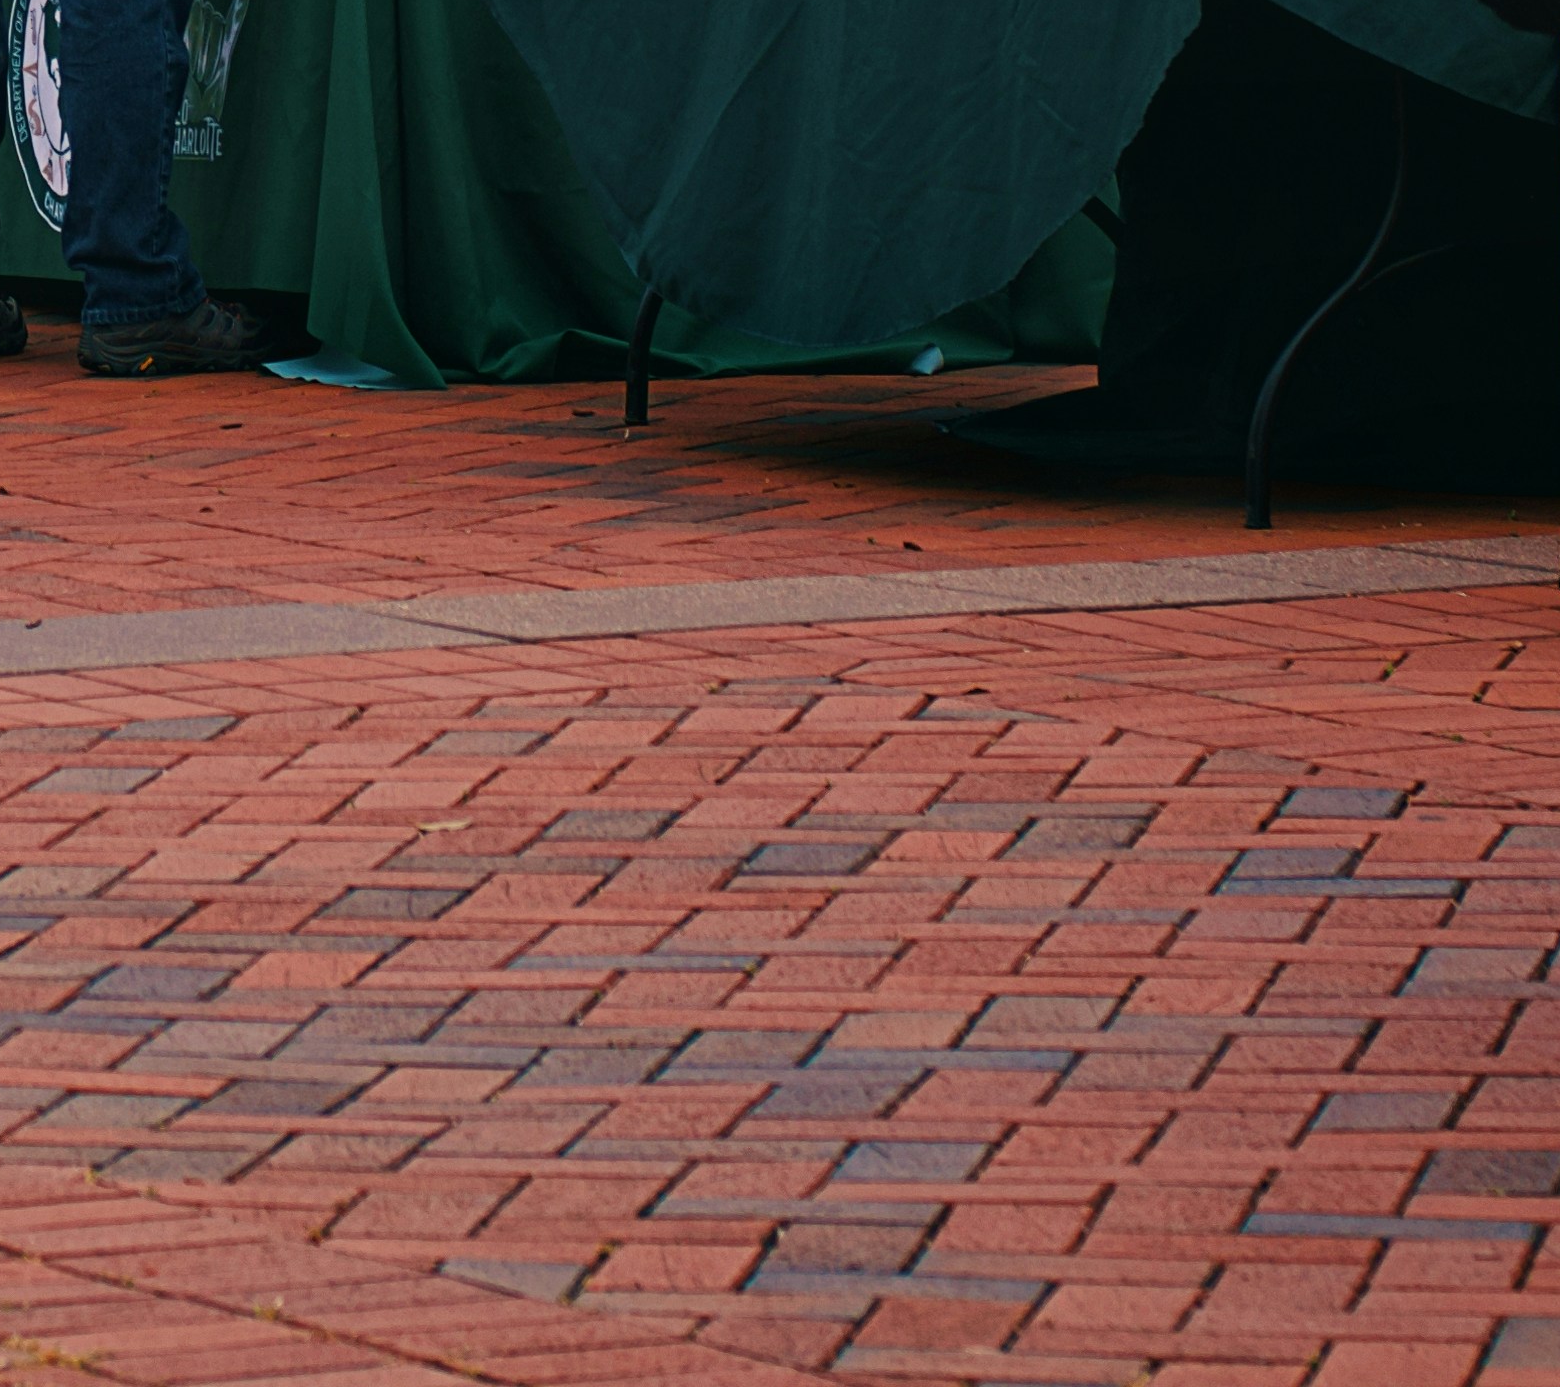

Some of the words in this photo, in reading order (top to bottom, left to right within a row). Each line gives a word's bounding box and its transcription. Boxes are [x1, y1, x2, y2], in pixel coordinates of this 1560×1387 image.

[11, 38, 29, 144] DEPARTMENT
[172, 115, 224, 162] HARLOTTE
[43, 190, 68, 223] CHAR
